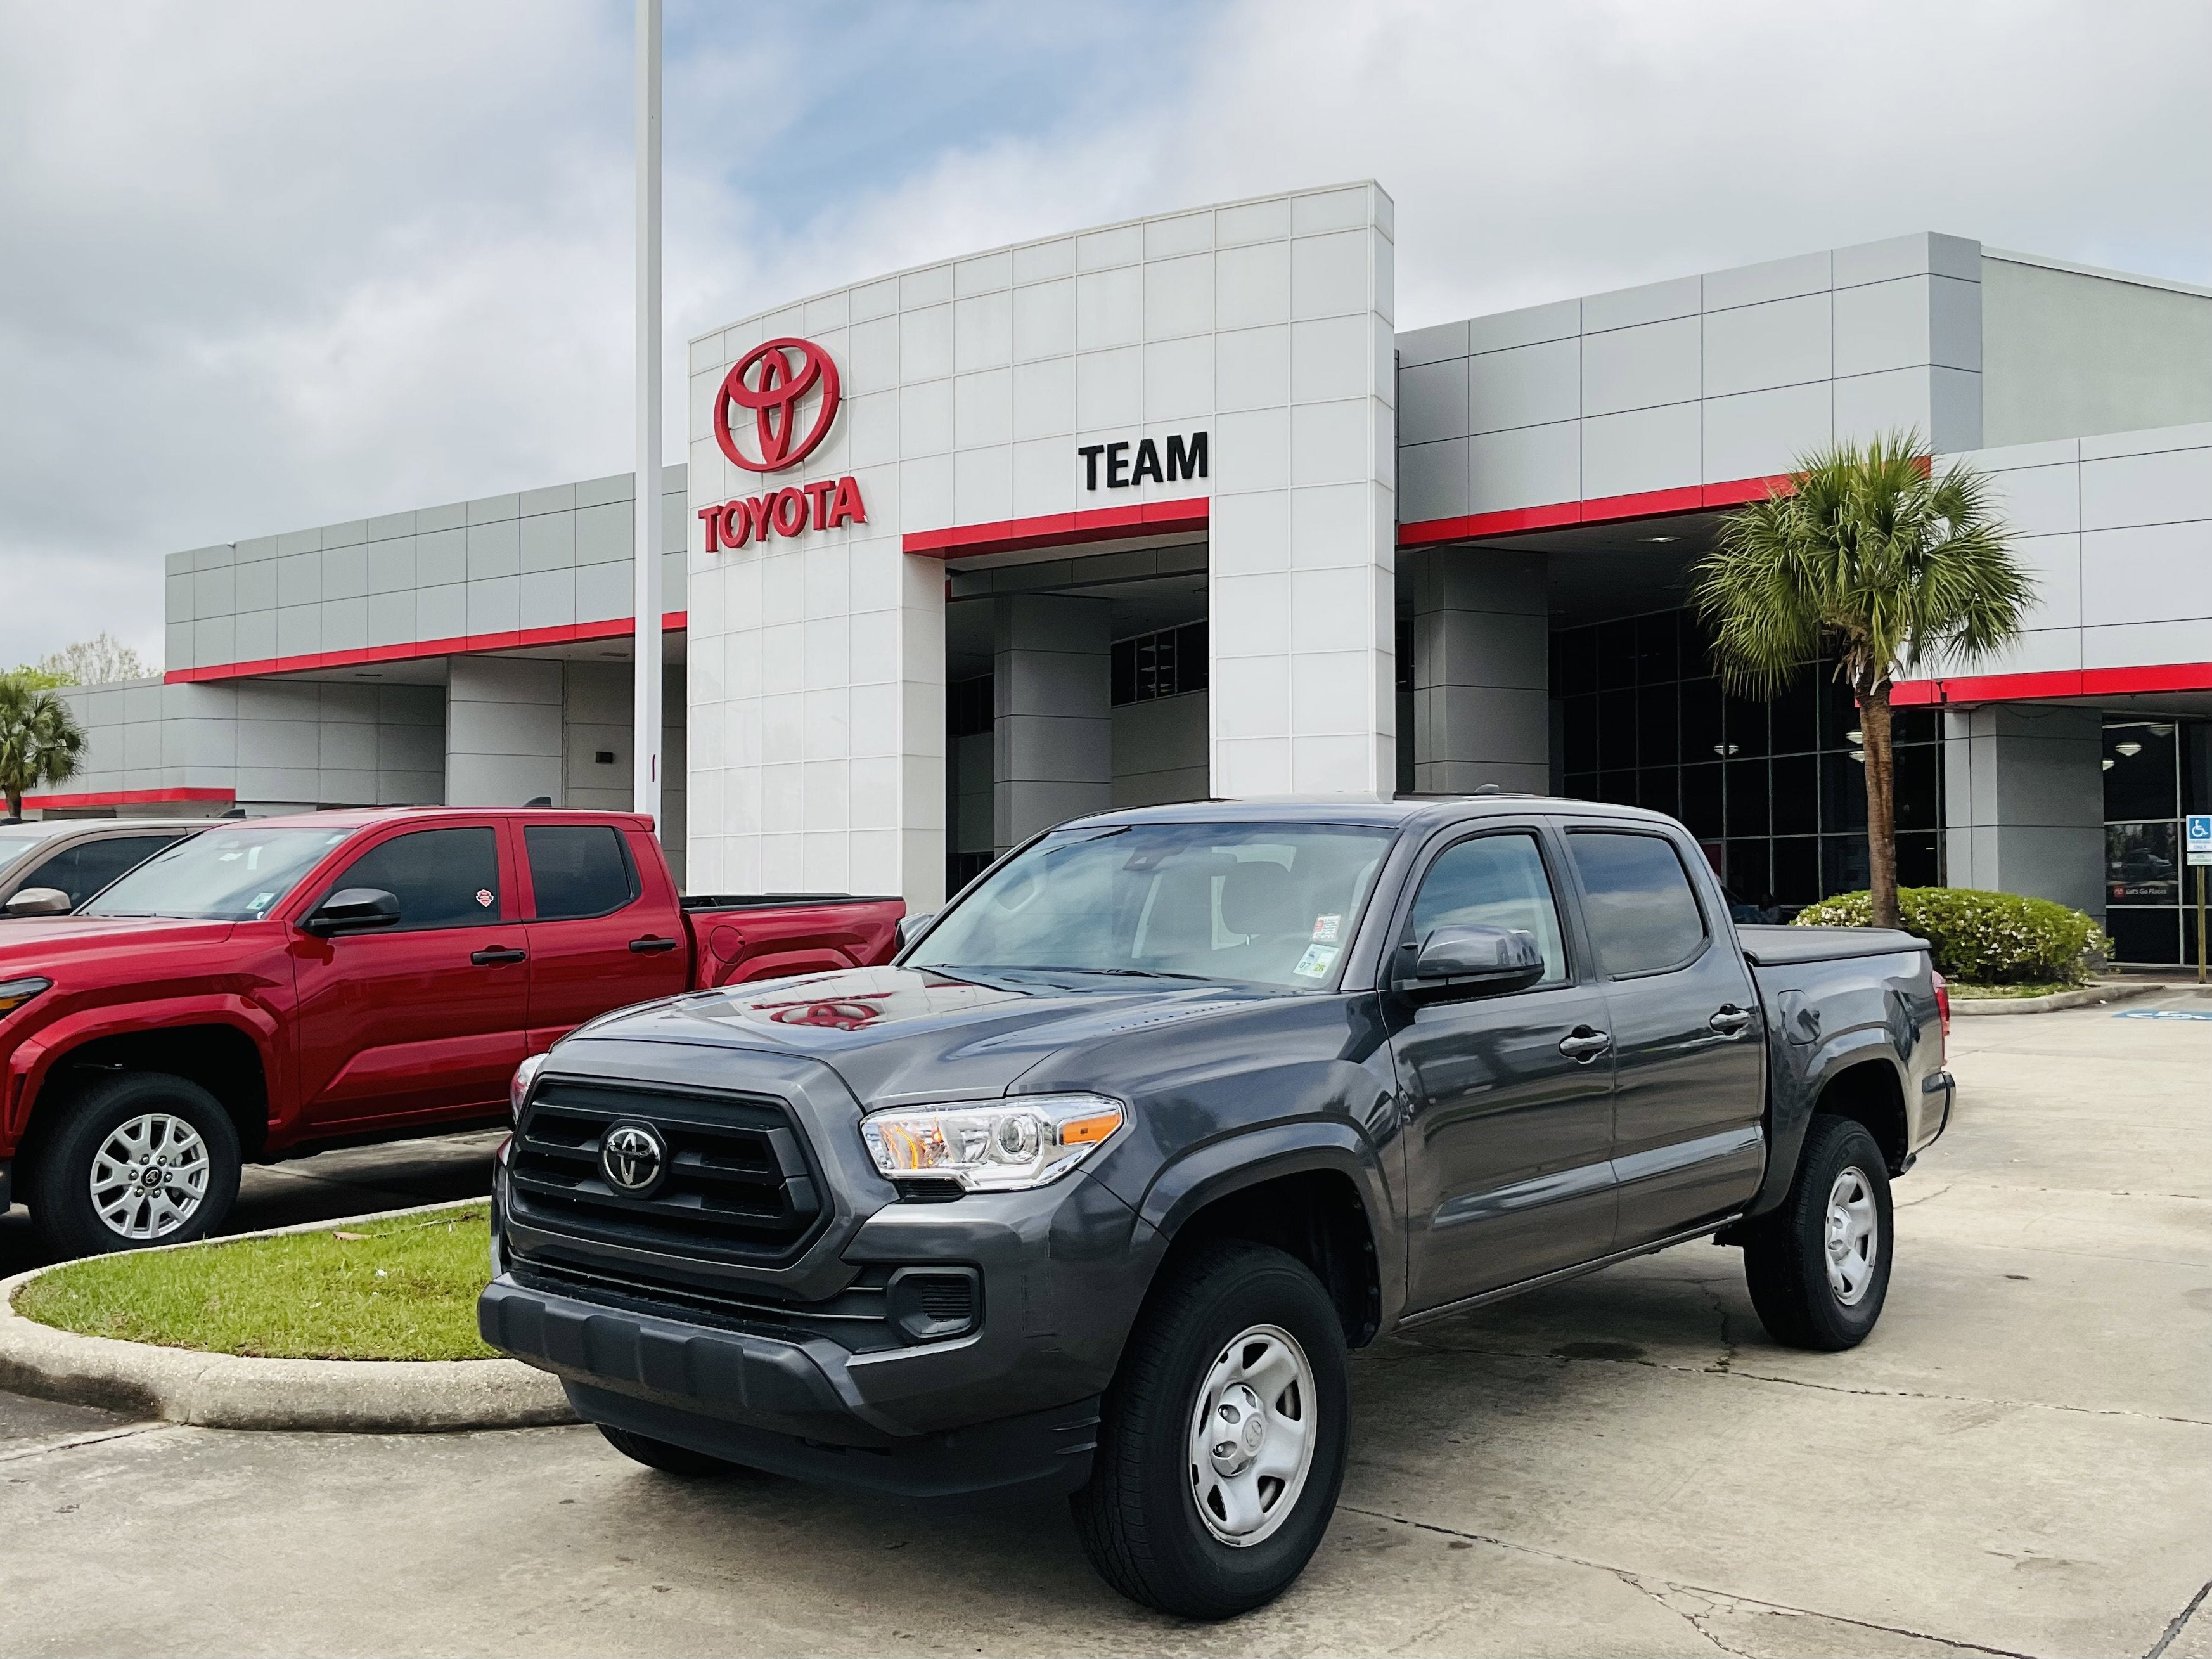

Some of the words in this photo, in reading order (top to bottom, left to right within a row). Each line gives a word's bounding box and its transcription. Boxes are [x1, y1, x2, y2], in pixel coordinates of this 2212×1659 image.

[1078, 432, 1208, 490] TEAM
[698, 477, 868, 553] TOYOTA
[1299, 961, 1311, 969] 07
[1313, 964, 1325, 972] 26
